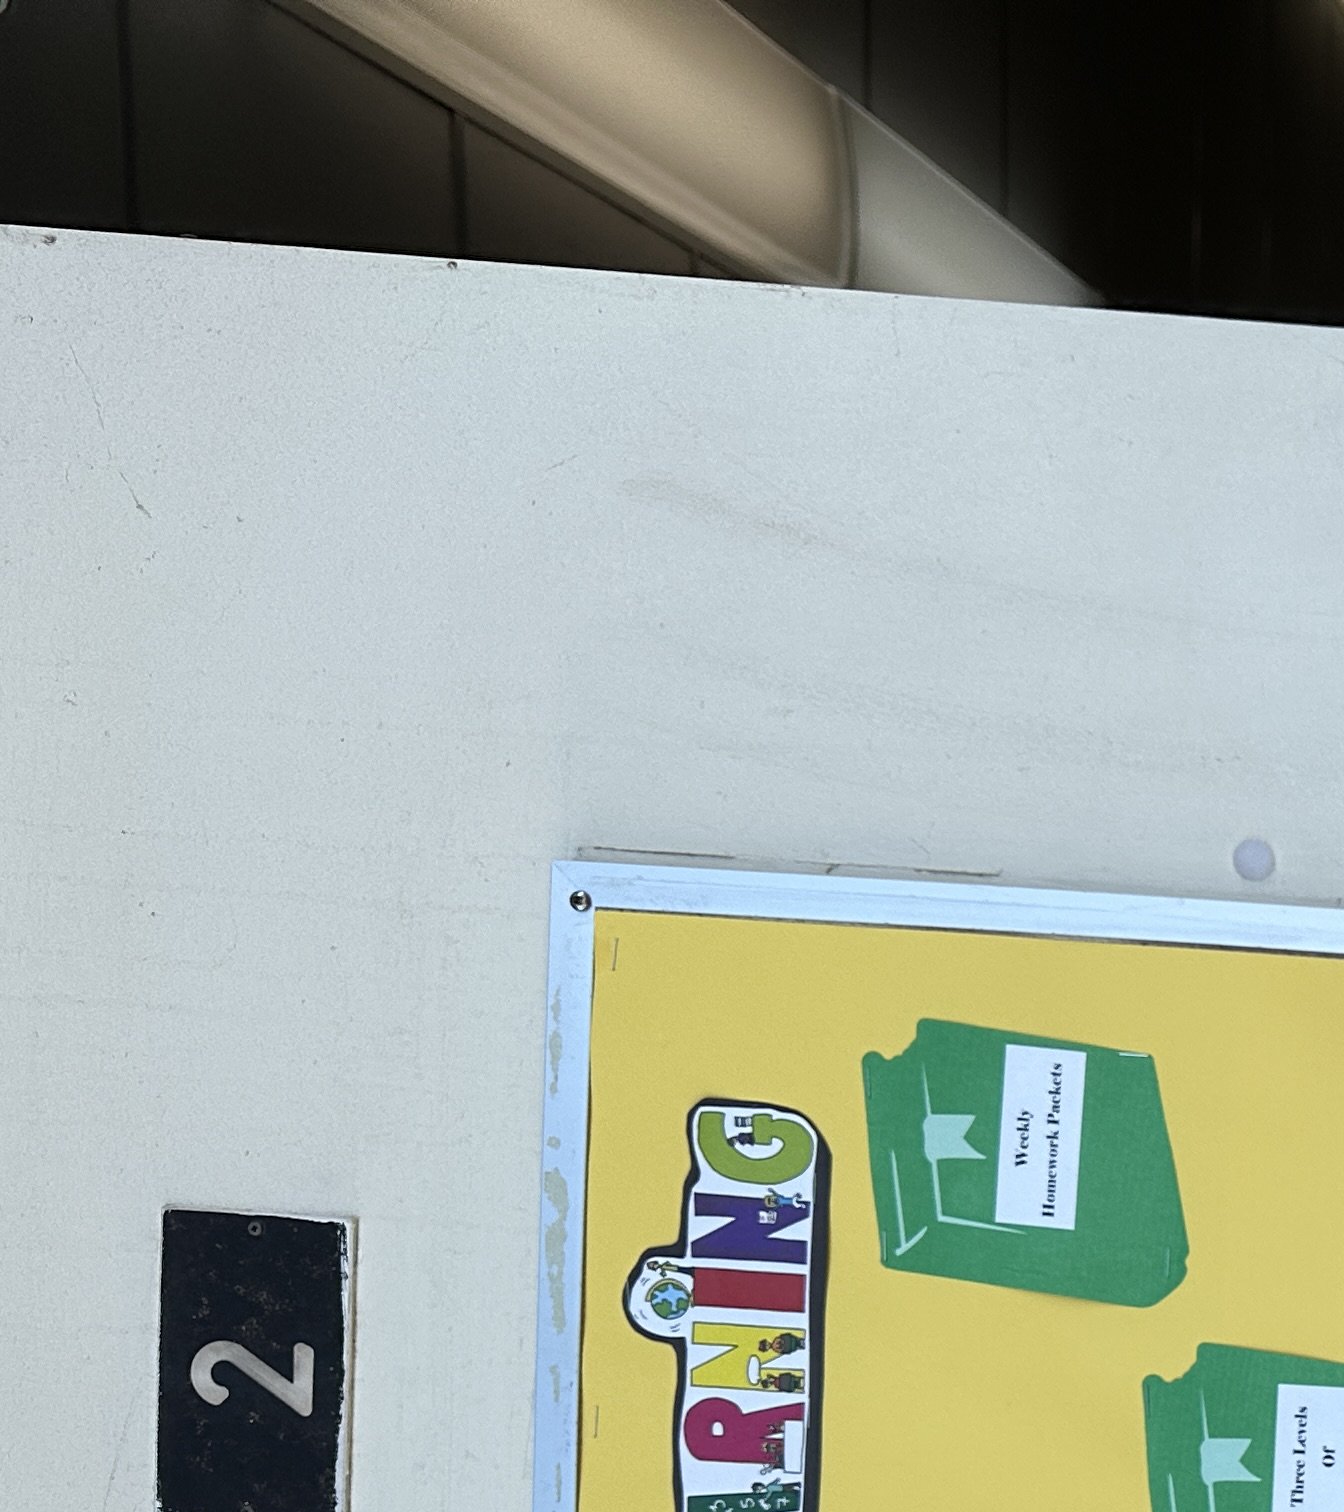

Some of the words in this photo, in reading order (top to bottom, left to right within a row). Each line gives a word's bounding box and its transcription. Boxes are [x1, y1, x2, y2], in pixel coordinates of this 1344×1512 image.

[1046, 1063, 1062, 1125] Packets
[1014, 1110, 1034, 1167] Weekly
[1041, 1130, 1060, 1218] Homework
[190, 1340, 315, 1423] 2
[1292, 1406, 1308, 1455] Levels
[1322, 1445, 1336, 1468] Of
[1290, 1460, 1306, 1508] Three
